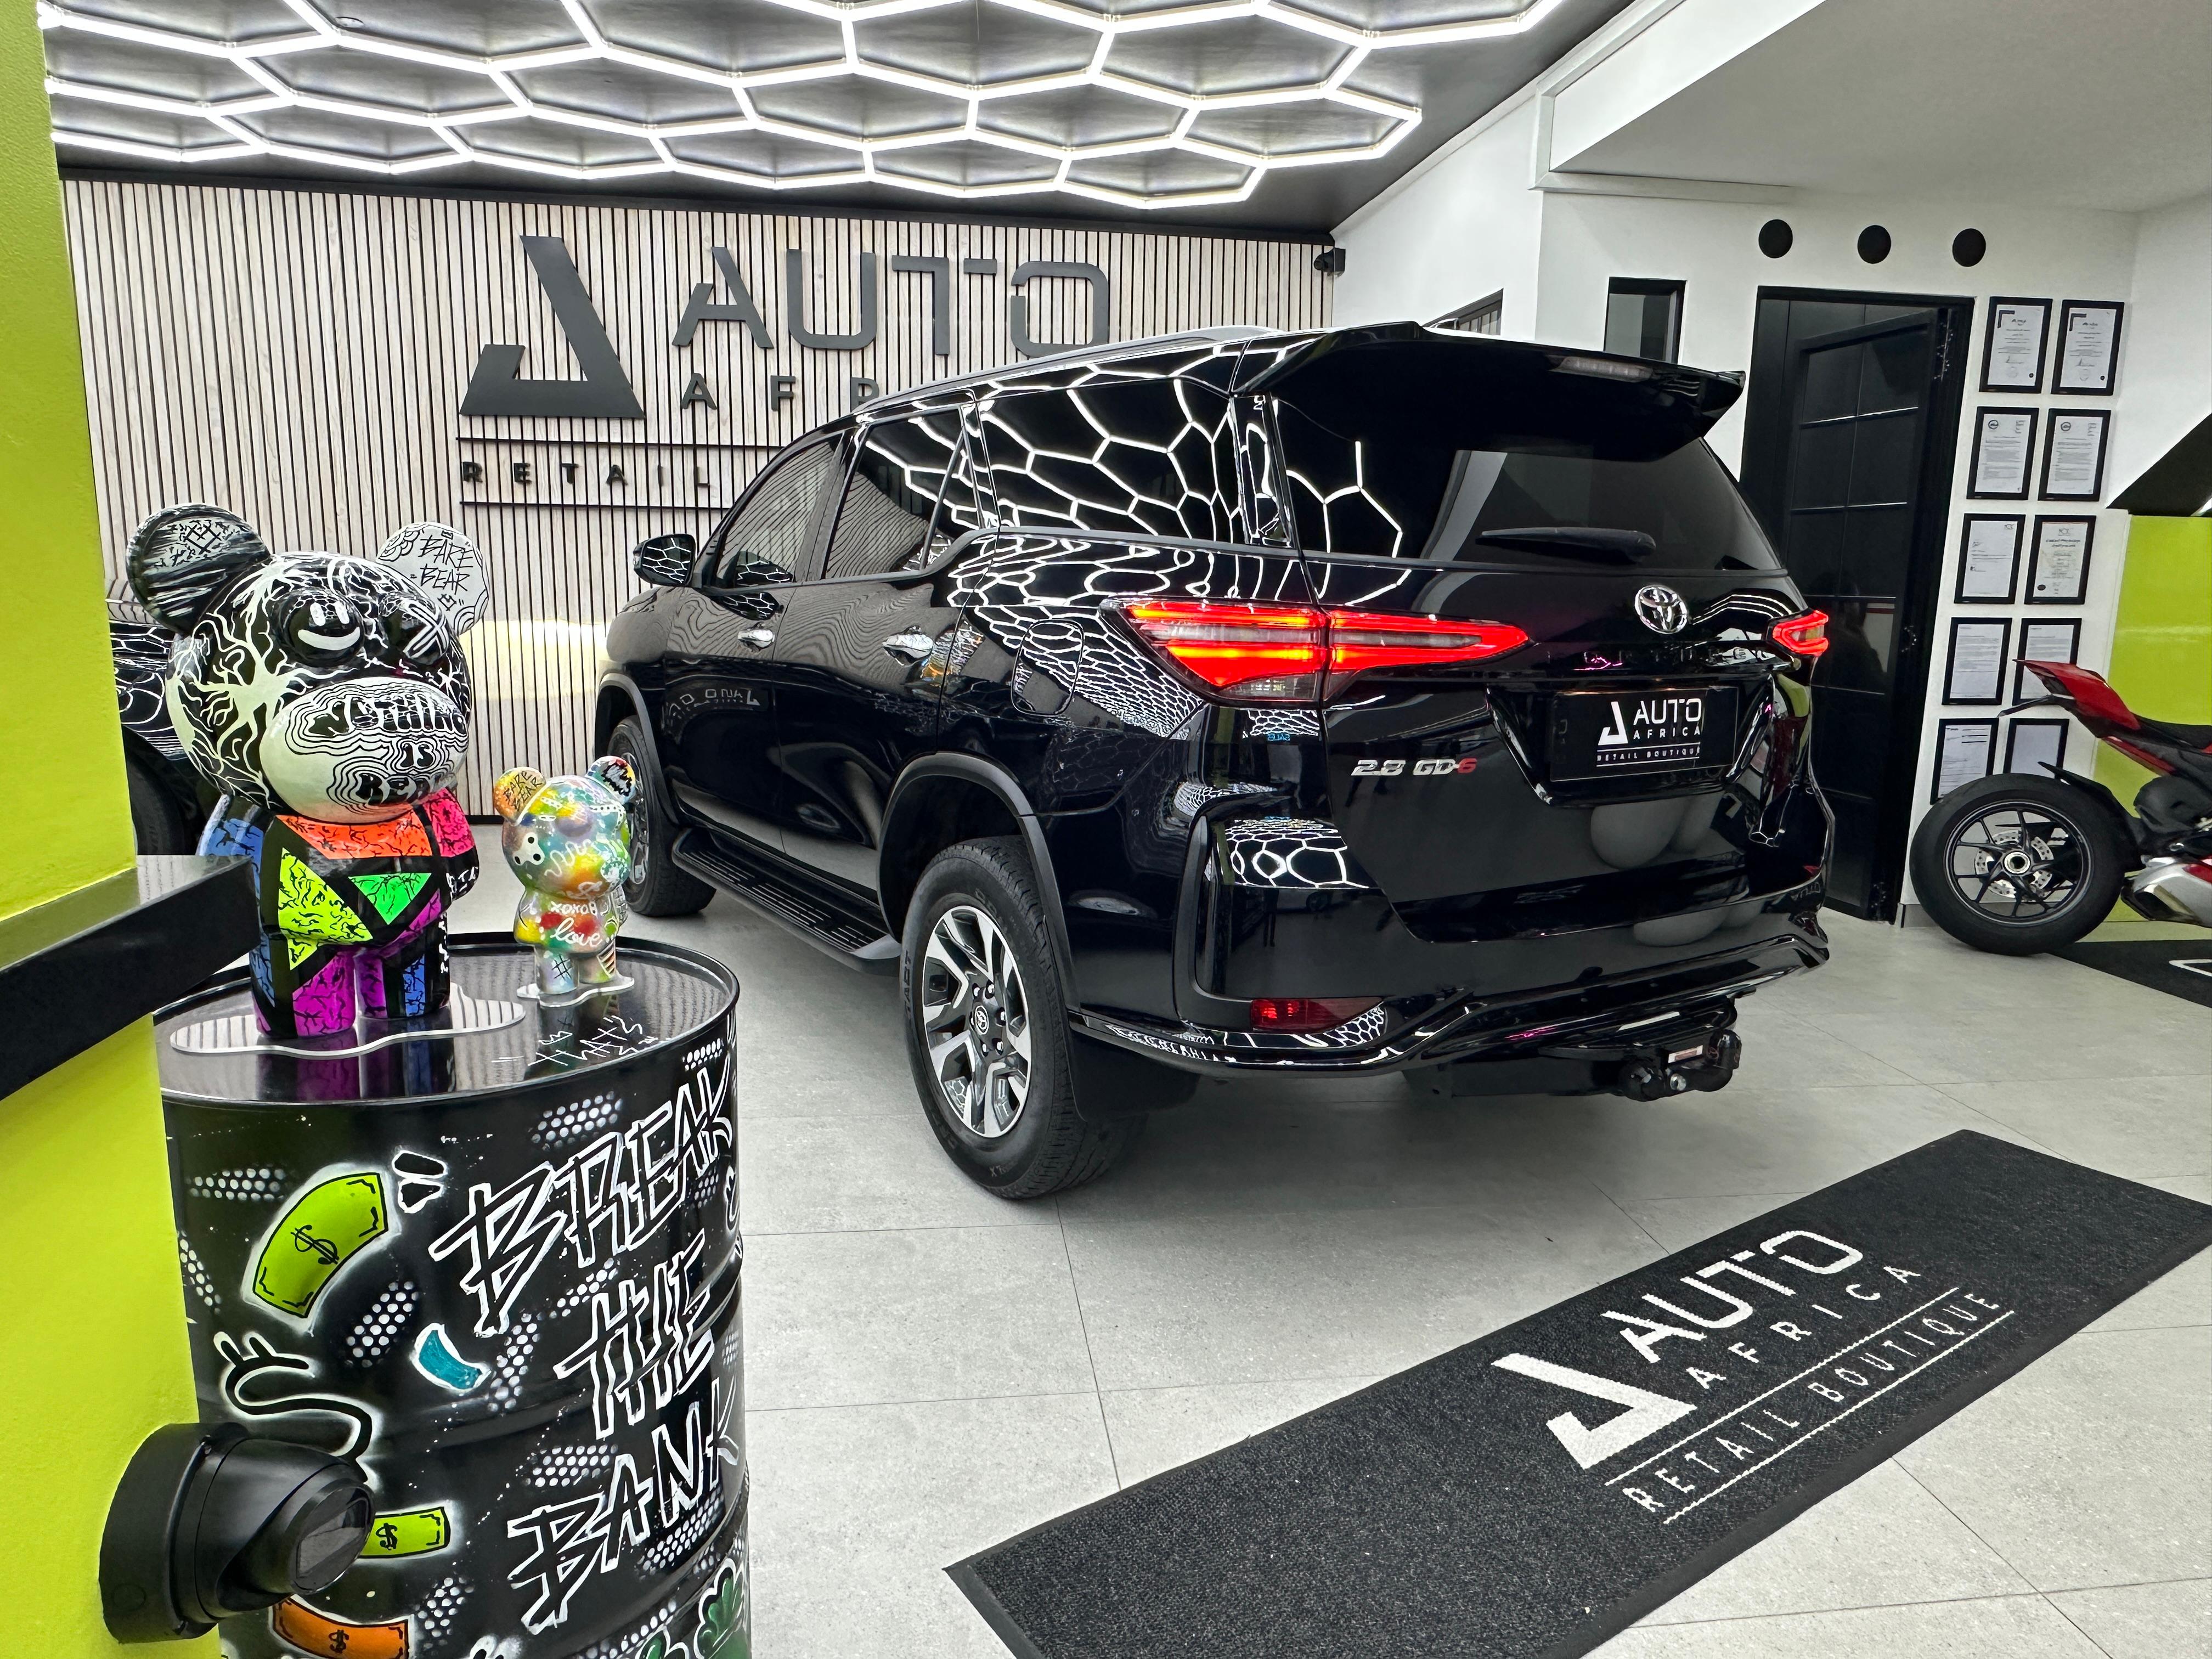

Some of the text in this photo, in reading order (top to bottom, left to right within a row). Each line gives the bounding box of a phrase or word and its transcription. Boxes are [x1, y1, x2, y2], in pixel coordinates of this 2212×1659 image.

[672, 246, 1110, 360] AUTO
[462, 460, 711, 489] RETAIL
[418, 534, 474, 572] BARE
[420, 563, 468, 595] BEAR
[1633, 698, 1702, 726] AUTO
[1633, 725, 1701, 740] AFRICA
[400, 742, 435, 768] IS
[1351, 757, 1478, 776] 2.8 GD-6
[550, 917, 602, 947] love
[428, 1053, 733, 1336] BREAK
[1600, 1229, 1864, 1363] AUTO
[553, 1229, 715, 1440] THE
[1684, 1265, 1922, 1390] AFRICA
[1622, 1291, 2000, 1513] RETAIL BOUTIQUE
[506, 1376, 741, 1635] BANK
